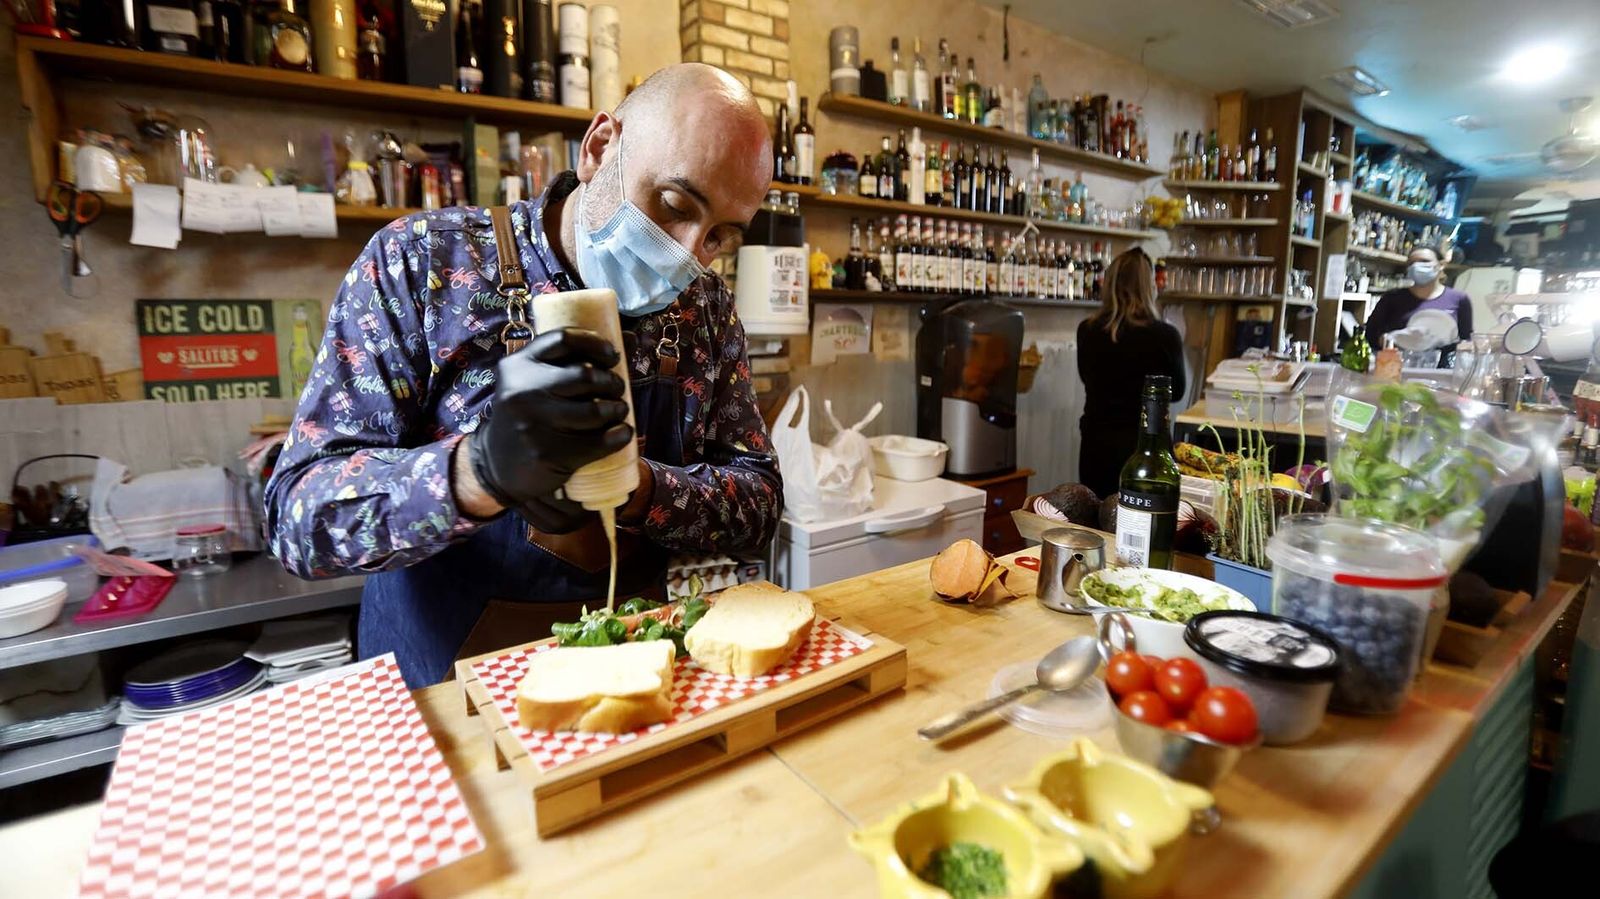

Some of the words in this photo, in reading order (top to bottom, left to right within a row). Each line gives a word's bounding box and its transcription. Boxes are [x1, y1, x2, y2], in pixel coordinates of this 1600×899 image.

[144, 304, 190, 333] ICE
[198, 304, 264, 333] COLD
[1123, 494, 1152, 507] PEPE
